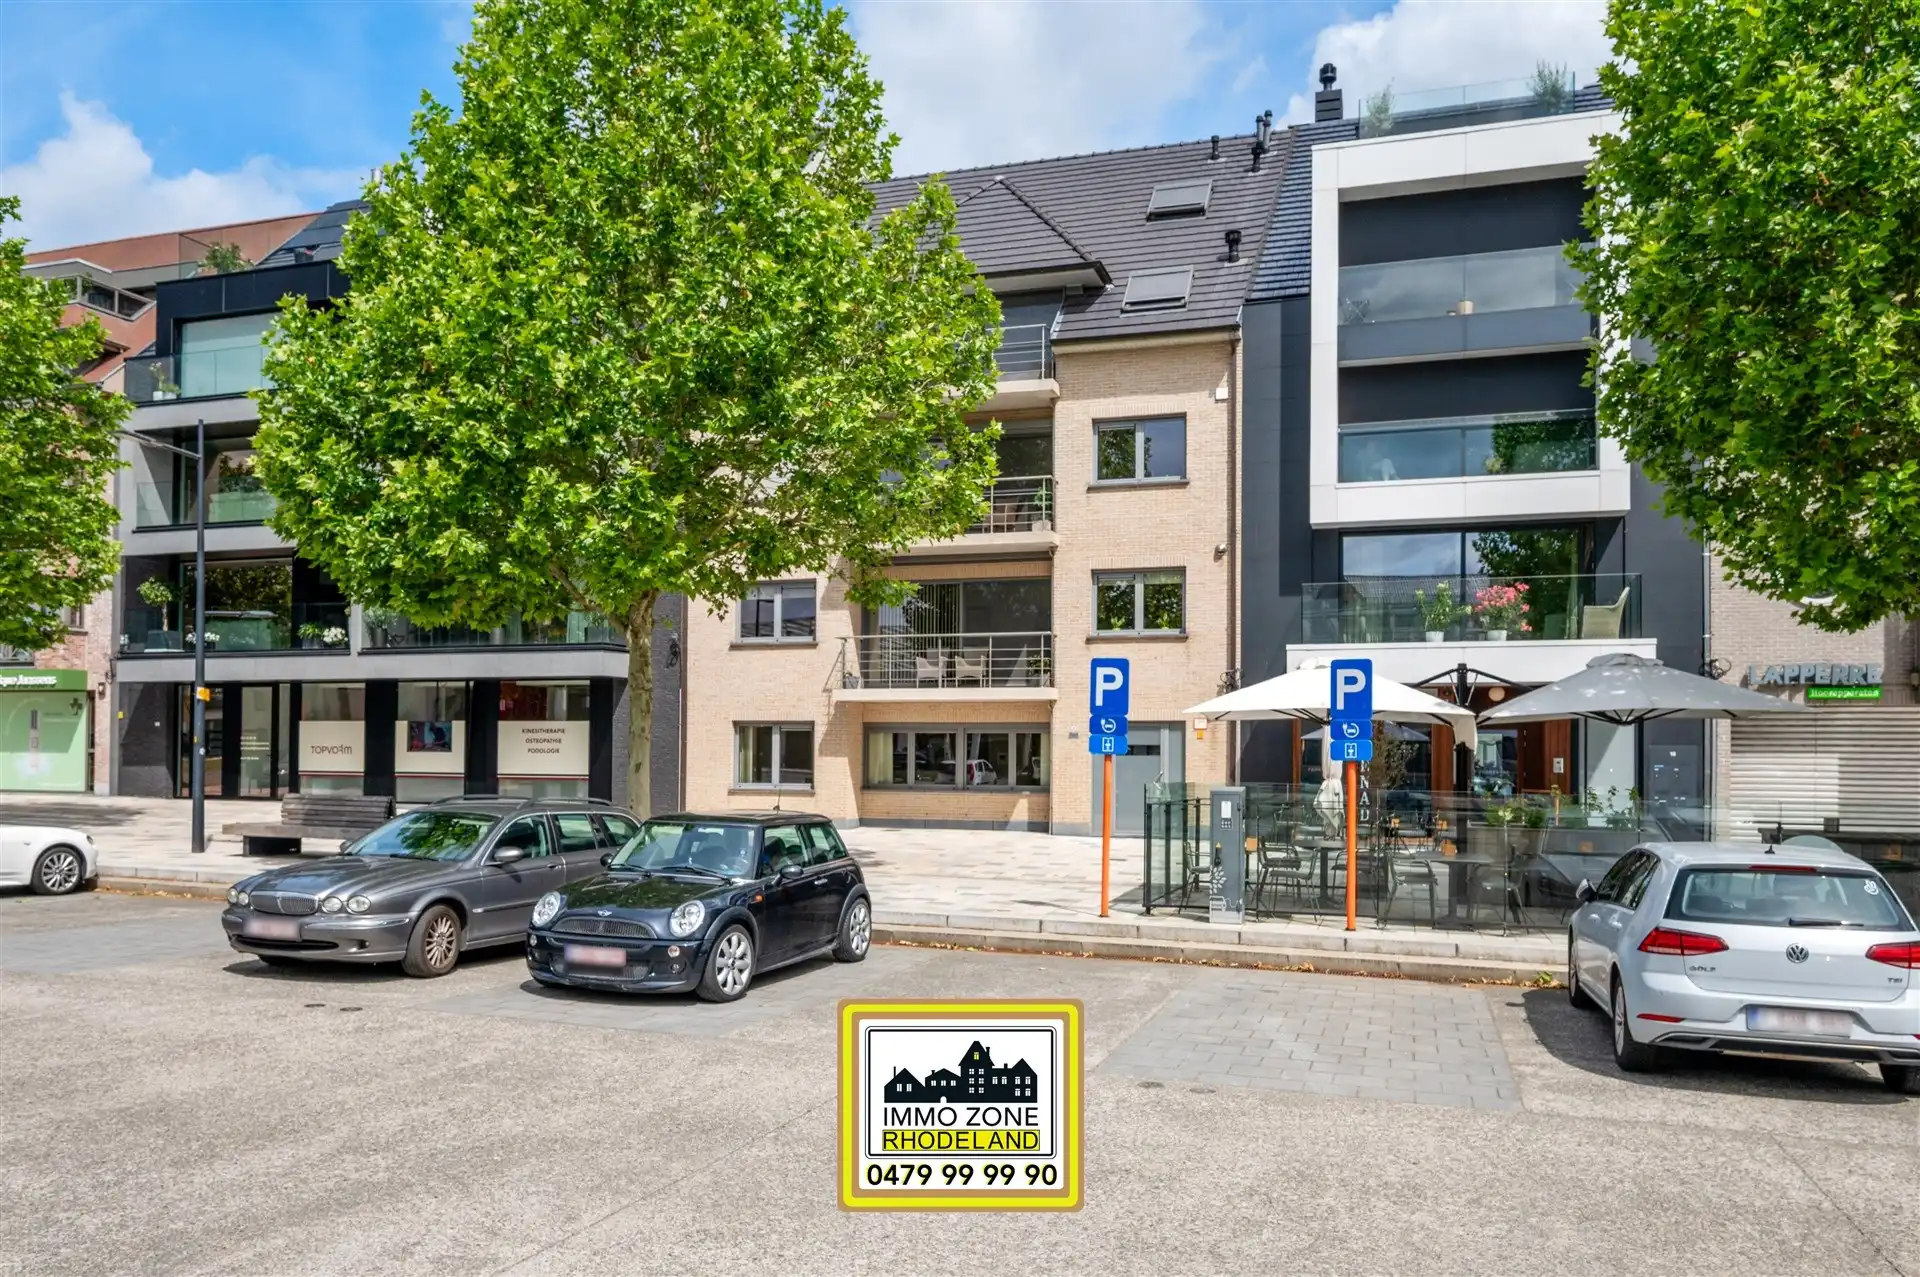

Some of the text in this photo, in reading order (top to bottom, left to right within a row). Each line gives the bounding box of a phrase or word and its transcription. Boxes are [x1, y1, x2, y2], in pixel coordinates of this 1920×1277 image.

[1095, 666, 1124, 707] P
[1336, 668, 1366, 710] P
[1749, 664, 1883, 685] LAPPERRE
